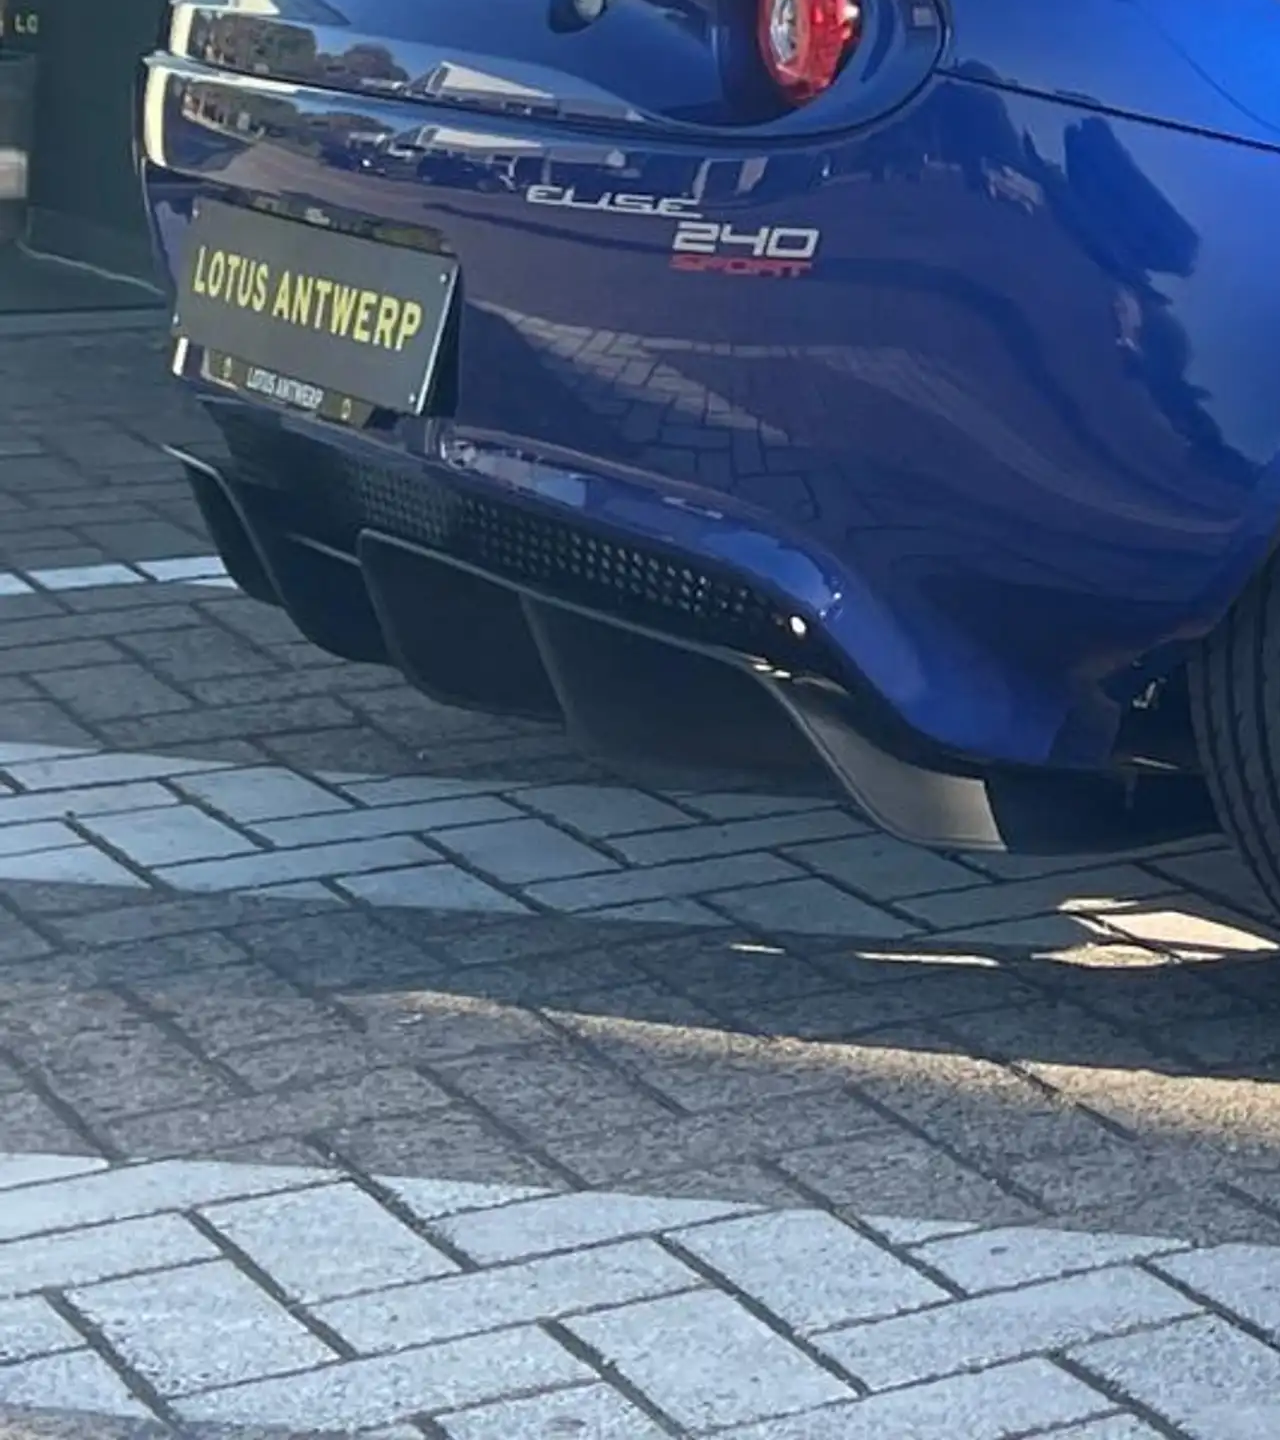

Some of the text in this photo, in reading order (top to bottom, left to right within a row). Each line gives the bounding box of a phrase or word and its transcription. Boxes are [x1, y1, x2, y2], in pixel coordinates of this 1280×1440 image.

[526, 184, 703, 219] ELISE
[672, 221, 820, 258] 240
[193, 245, 423, 352] LOTUS ANTWERP
